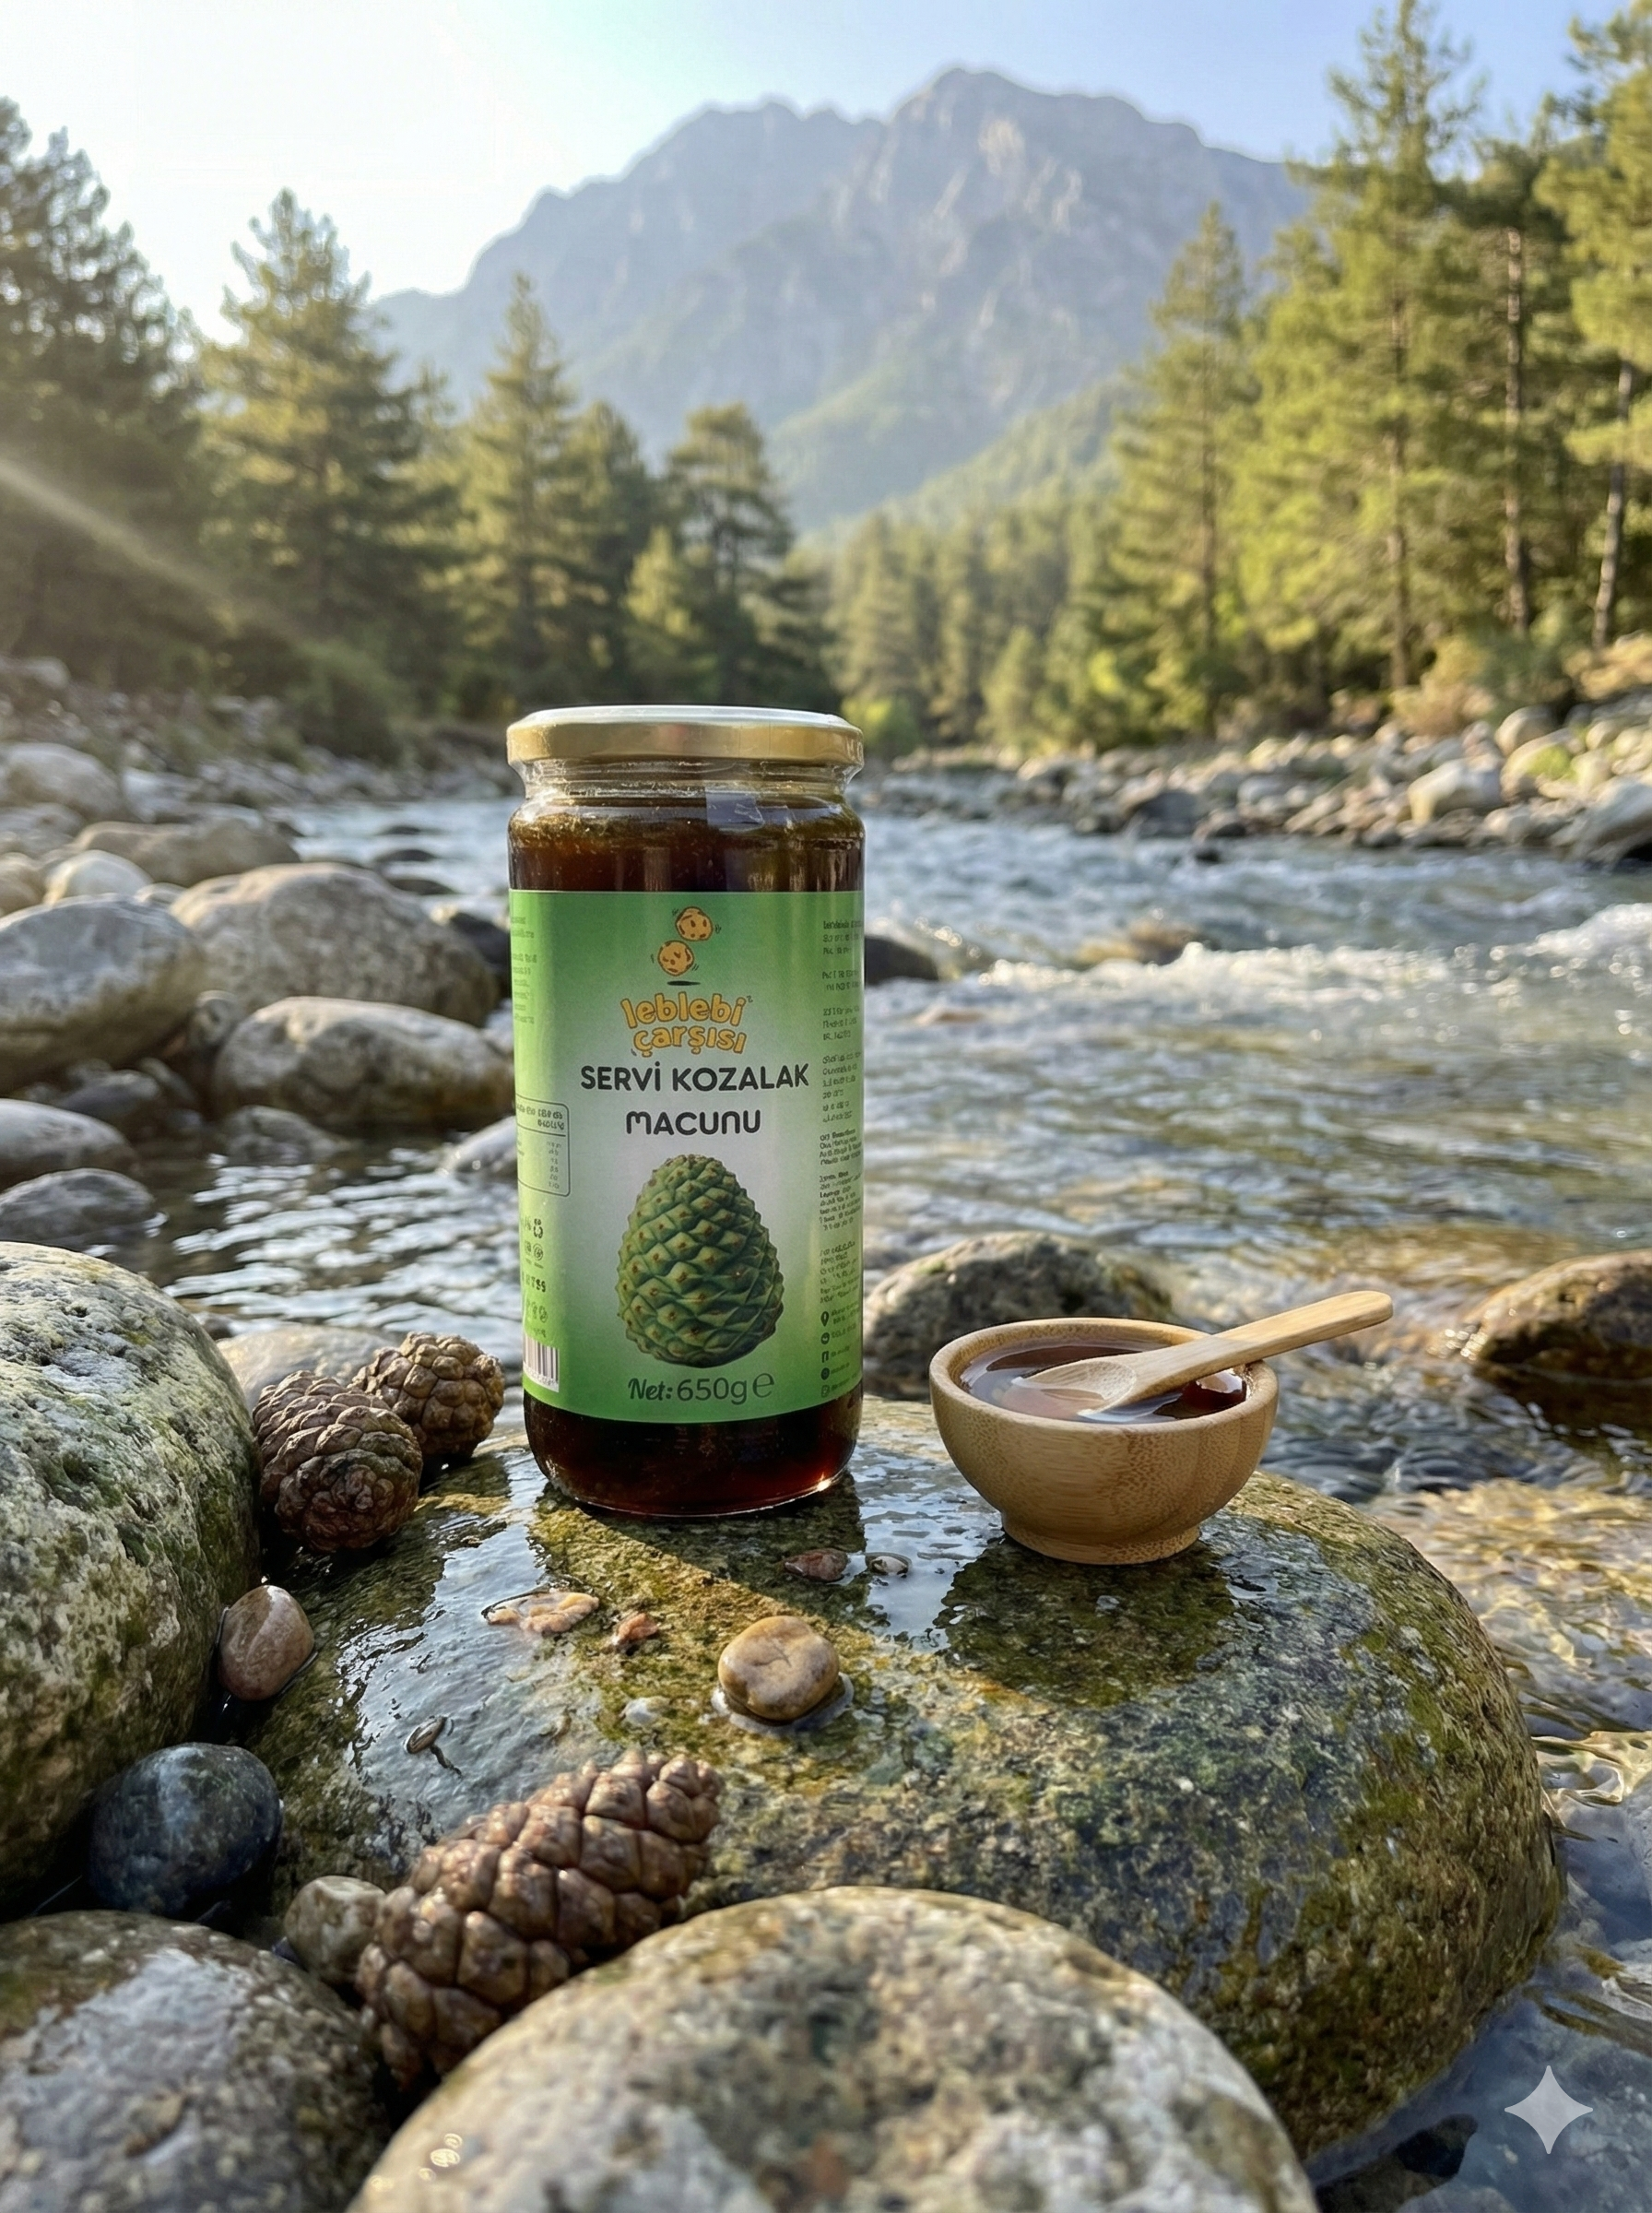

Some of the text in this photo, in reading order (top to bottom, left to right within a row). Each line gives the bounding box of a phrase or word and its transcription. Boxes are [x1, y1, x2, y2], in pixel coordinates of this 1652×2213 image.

[620, 991, 747, 1029] leblebi
[580, 1060, 662, 1092] SERVİ
[672, 1063, 810, 1092] KOZALAK
[625, 1109, 762, 1136] MACUNU
